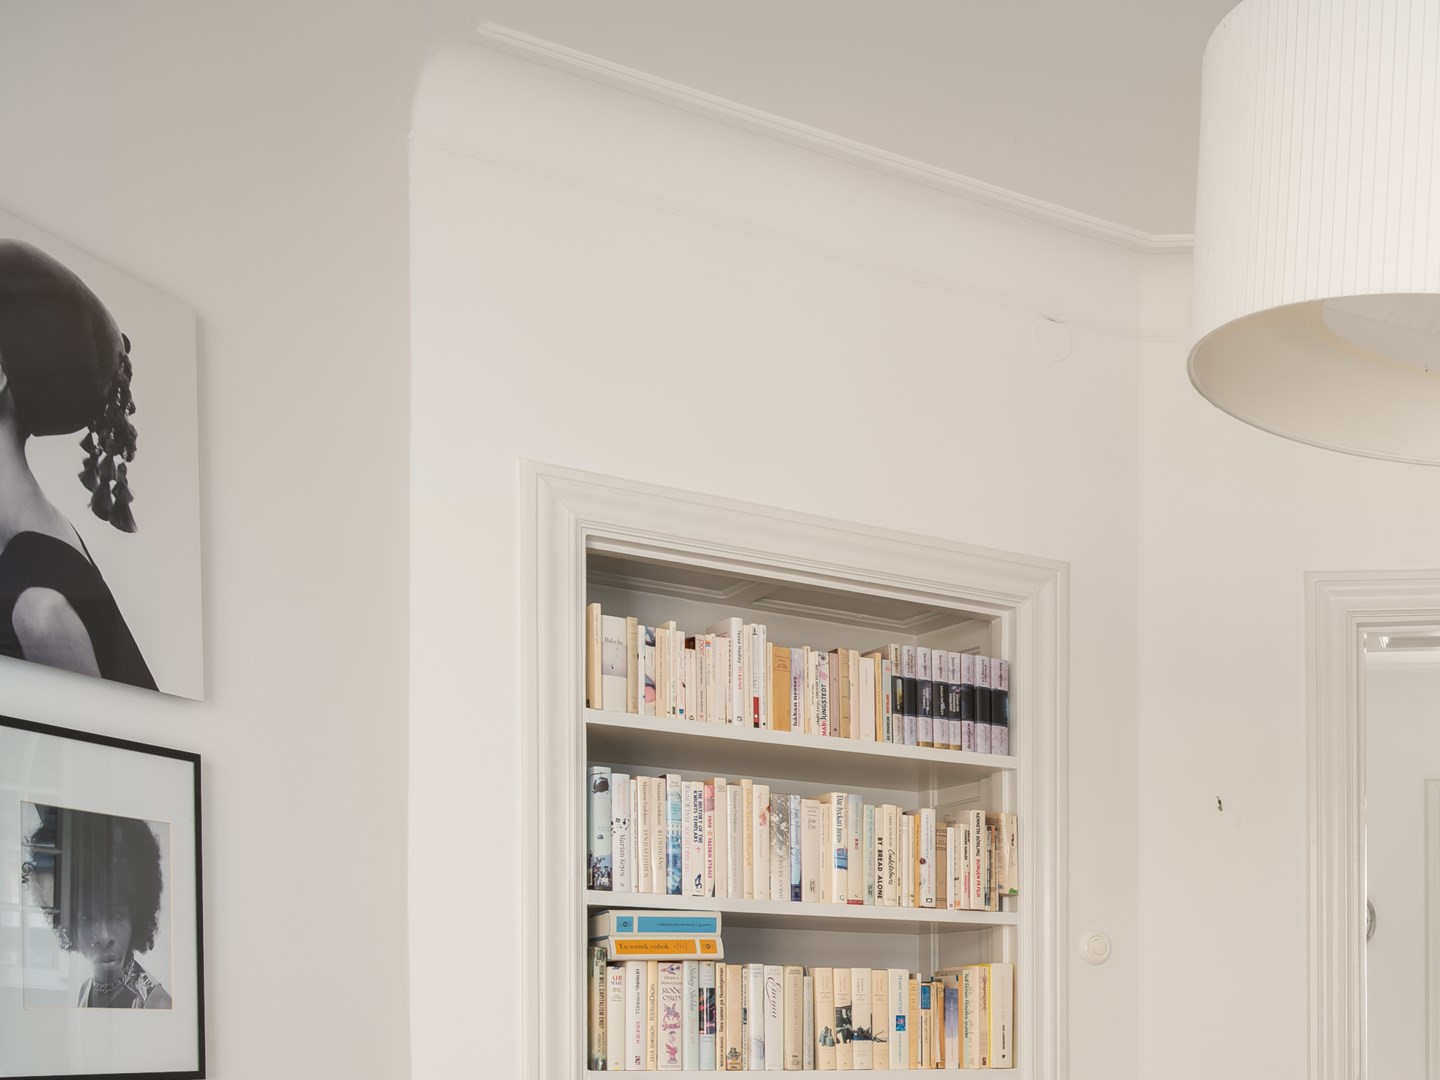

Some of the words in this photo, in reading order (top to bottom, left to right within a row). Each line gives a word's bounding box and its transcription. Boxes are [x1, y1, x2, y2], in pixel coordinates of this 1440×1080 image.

[697, 639, 705, 655] porr
[836, 807, 844, 826] lyckan
[766, 977, 782, 1019] Emma
